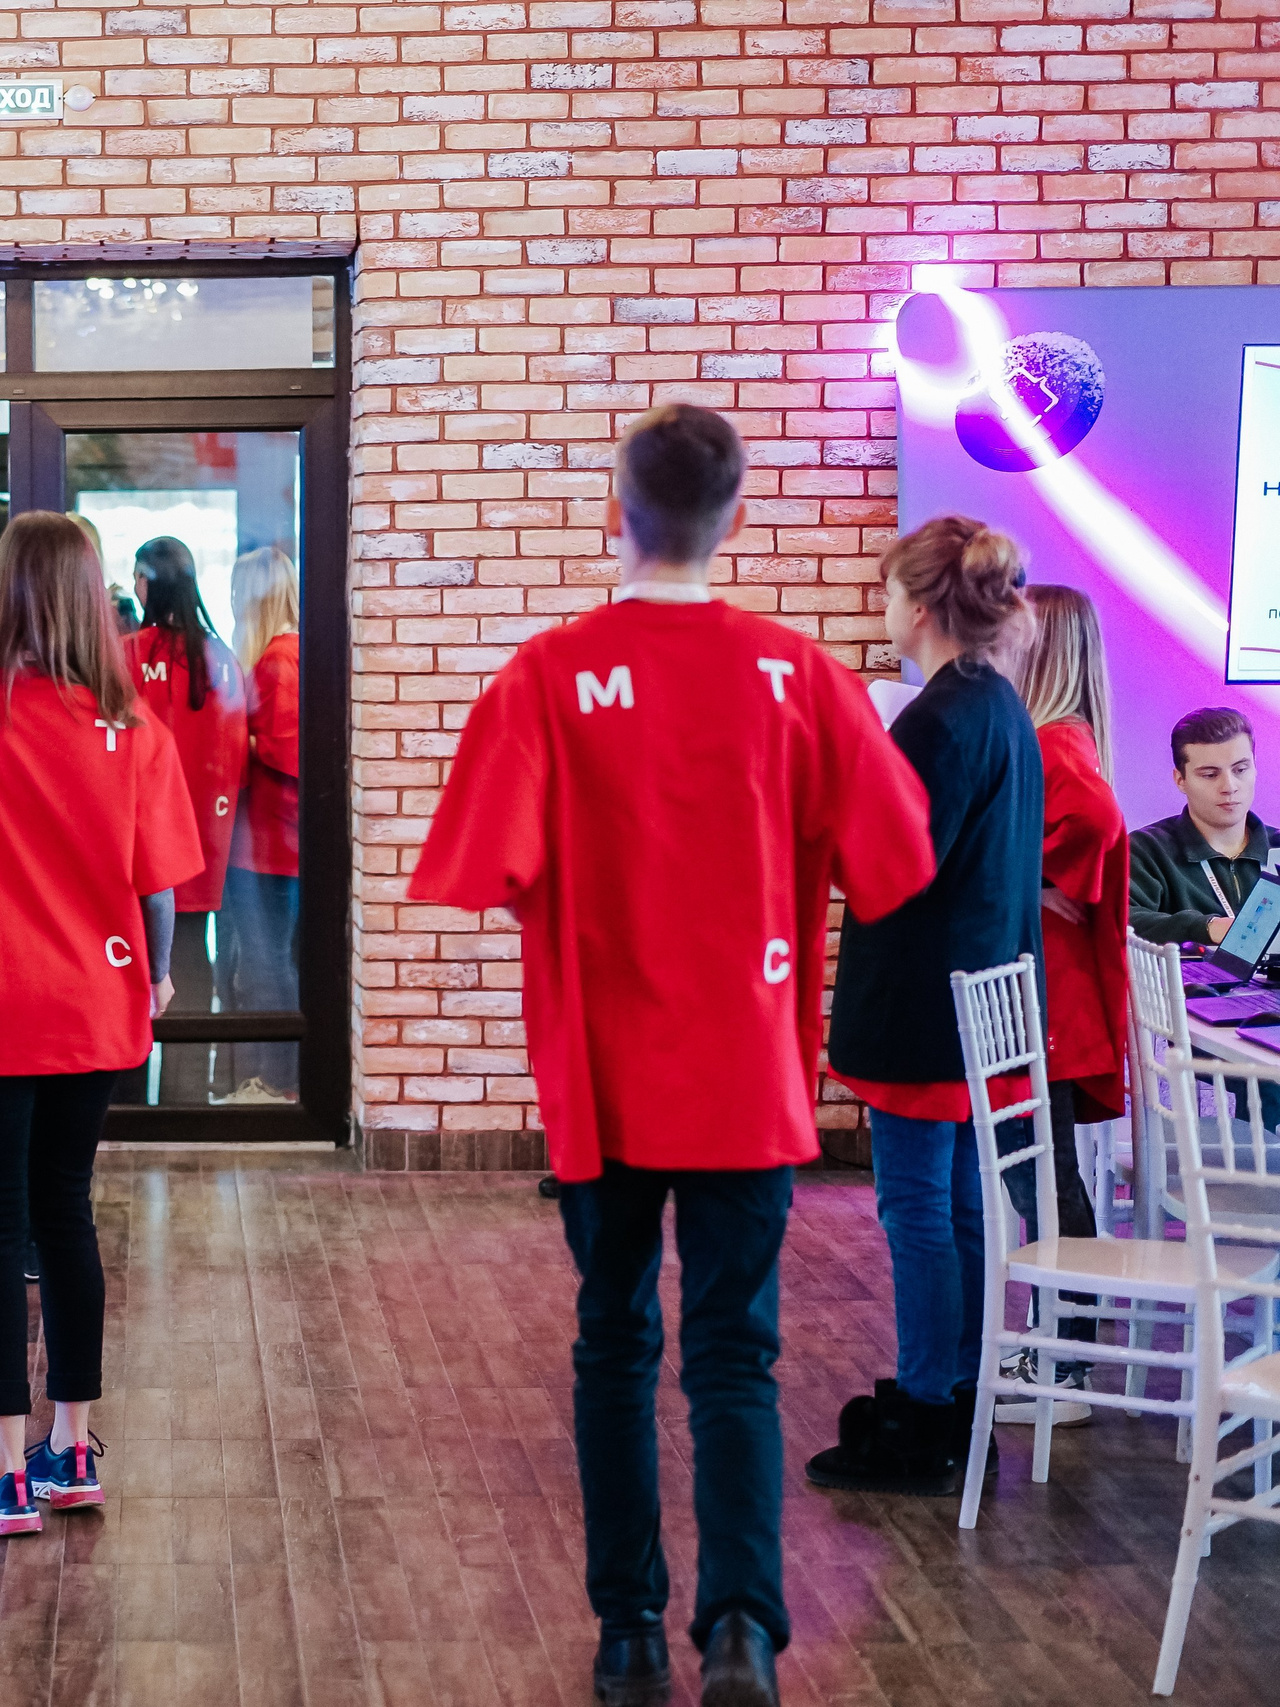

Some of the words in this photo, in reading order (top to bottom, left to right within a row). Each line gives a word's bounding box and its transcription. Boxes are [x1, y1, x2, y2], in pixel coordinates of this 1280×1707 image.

[575, 664, 635, 714] М
[757, 656, 795, 703] Т
[94, 719, 127, 751] Т
[215, 796, 229, 816] С
[105, 935, 133, 967] С
[763, 937, 791, 984] С
